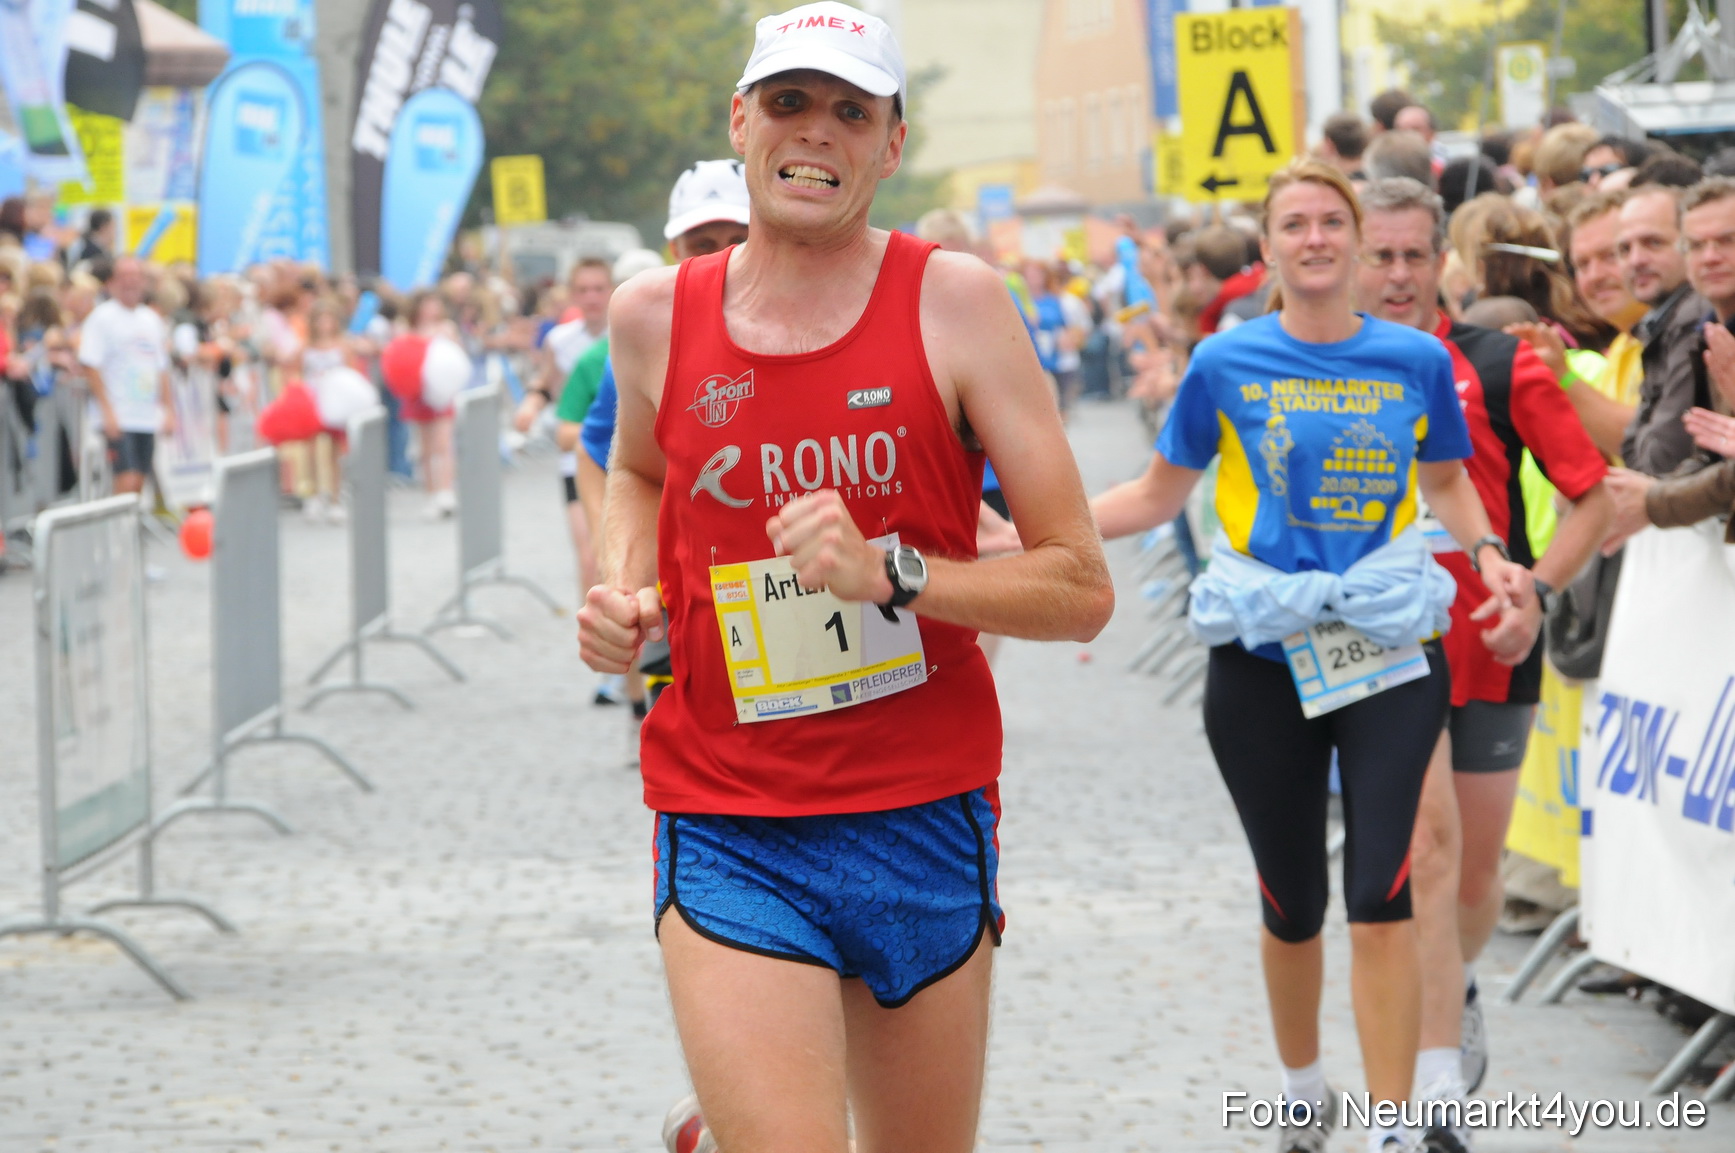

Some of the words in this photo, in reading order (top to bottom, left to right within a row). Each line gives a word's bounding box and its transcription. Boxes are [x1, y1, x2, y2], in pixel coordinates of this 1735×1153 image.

[776, 15, 865, 37] TIMEX
[1191, 16, 1288, 53] Block
[1211, 70, 1277, 158] A
[705, 379, 751, 400] SPORT
[863, 389, 890, 402] RONO
[1240, 383, 1268, 402] 10.
[1271, 378, 1404, 401] NEUMARKTER
[1269, 395, 1382, 415] STADTLAUF
[760, 430, 897, 494] RONO
[765, 480, 903, 508] INNOTIONS
[1320, 476, 1397, 495] 20.09.2009
[731, 625, 742, 647] A
[824, 611, 849, 653] 1
[1328, 636, 1398, 670] 283
[853, 663, 923, 693] PFLEIDERER
[755, 696, 803, 712] BOCK
